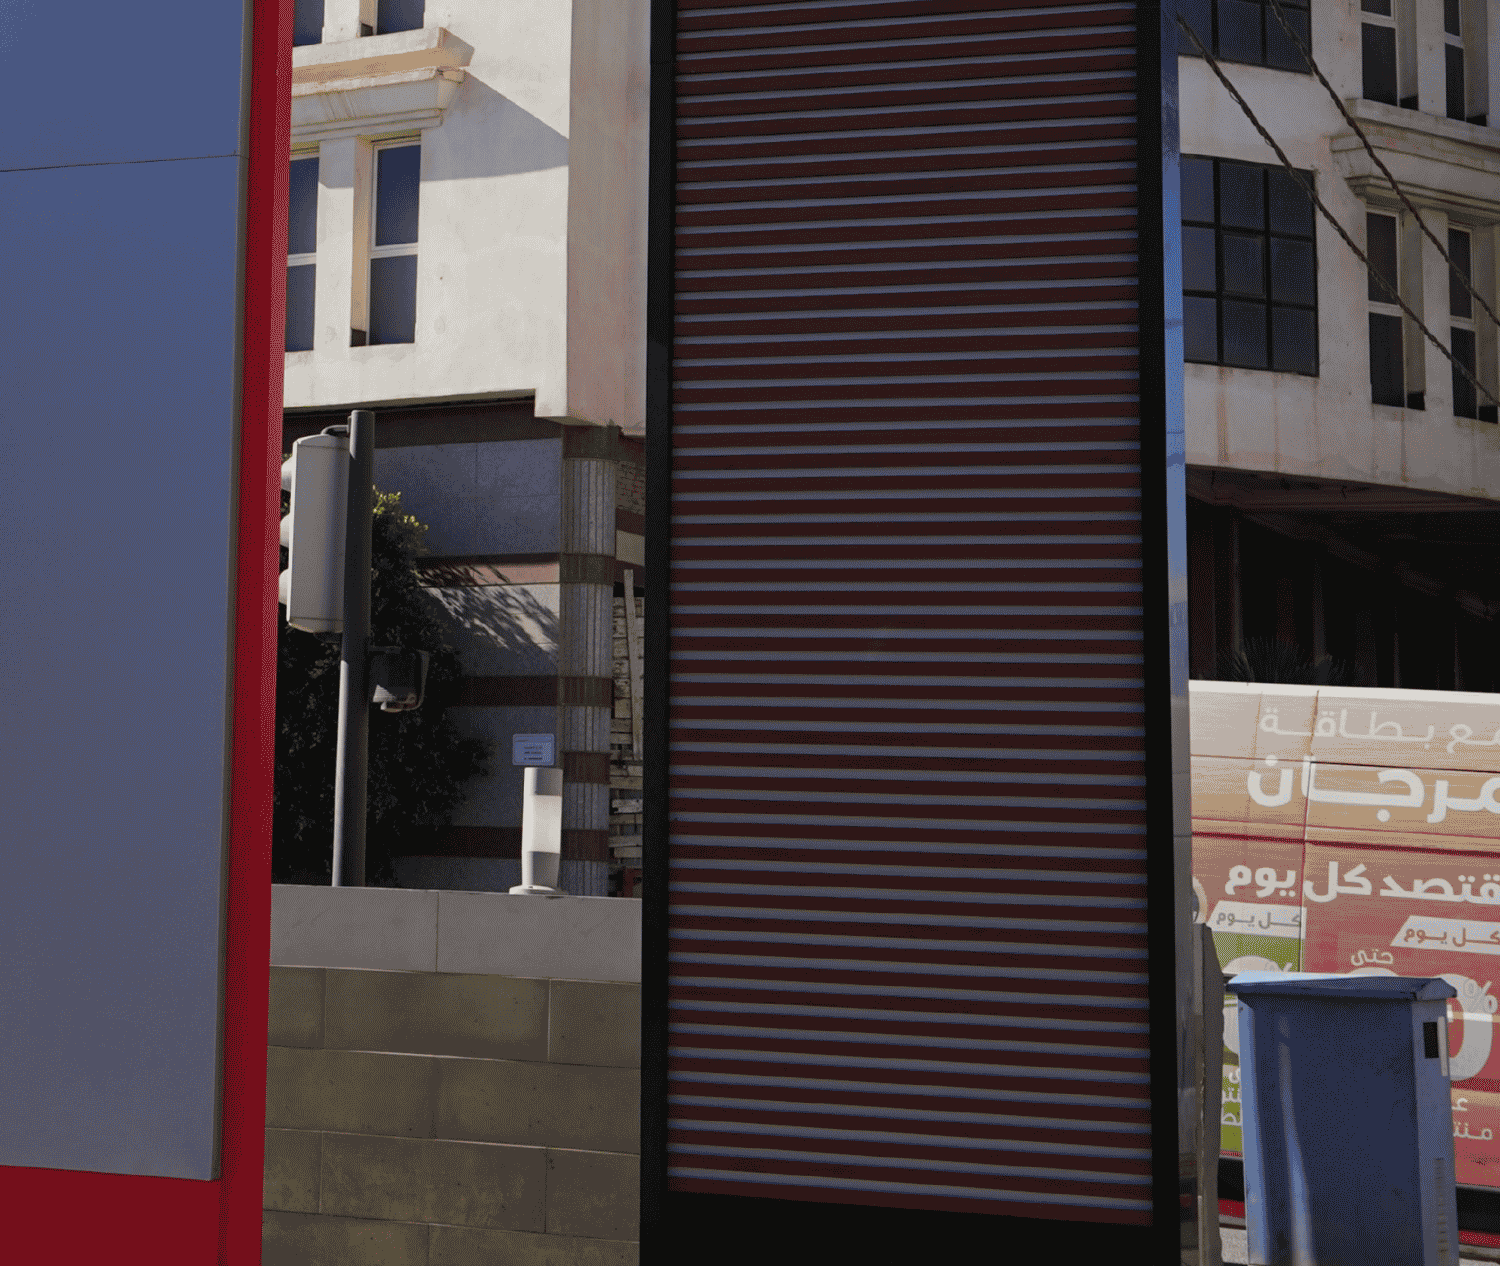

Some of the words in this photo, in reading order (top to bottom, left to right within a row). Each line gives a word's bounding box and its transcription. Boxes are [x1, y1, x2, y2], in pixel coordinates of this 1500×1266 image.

[1259, 707, 1435, 749] بطاقة
[1224, 864, 1297, 898] يوم
[1303, 861, 1373, 903] كل
[1216, 912, 1255, 927] يوم
[1258, 911, 1302, 929] كل
[1403, 928, 1448, 945] يوم
[1452, 927, 1500, 948] كل
[1350, 948, 1394, 966] حتى
